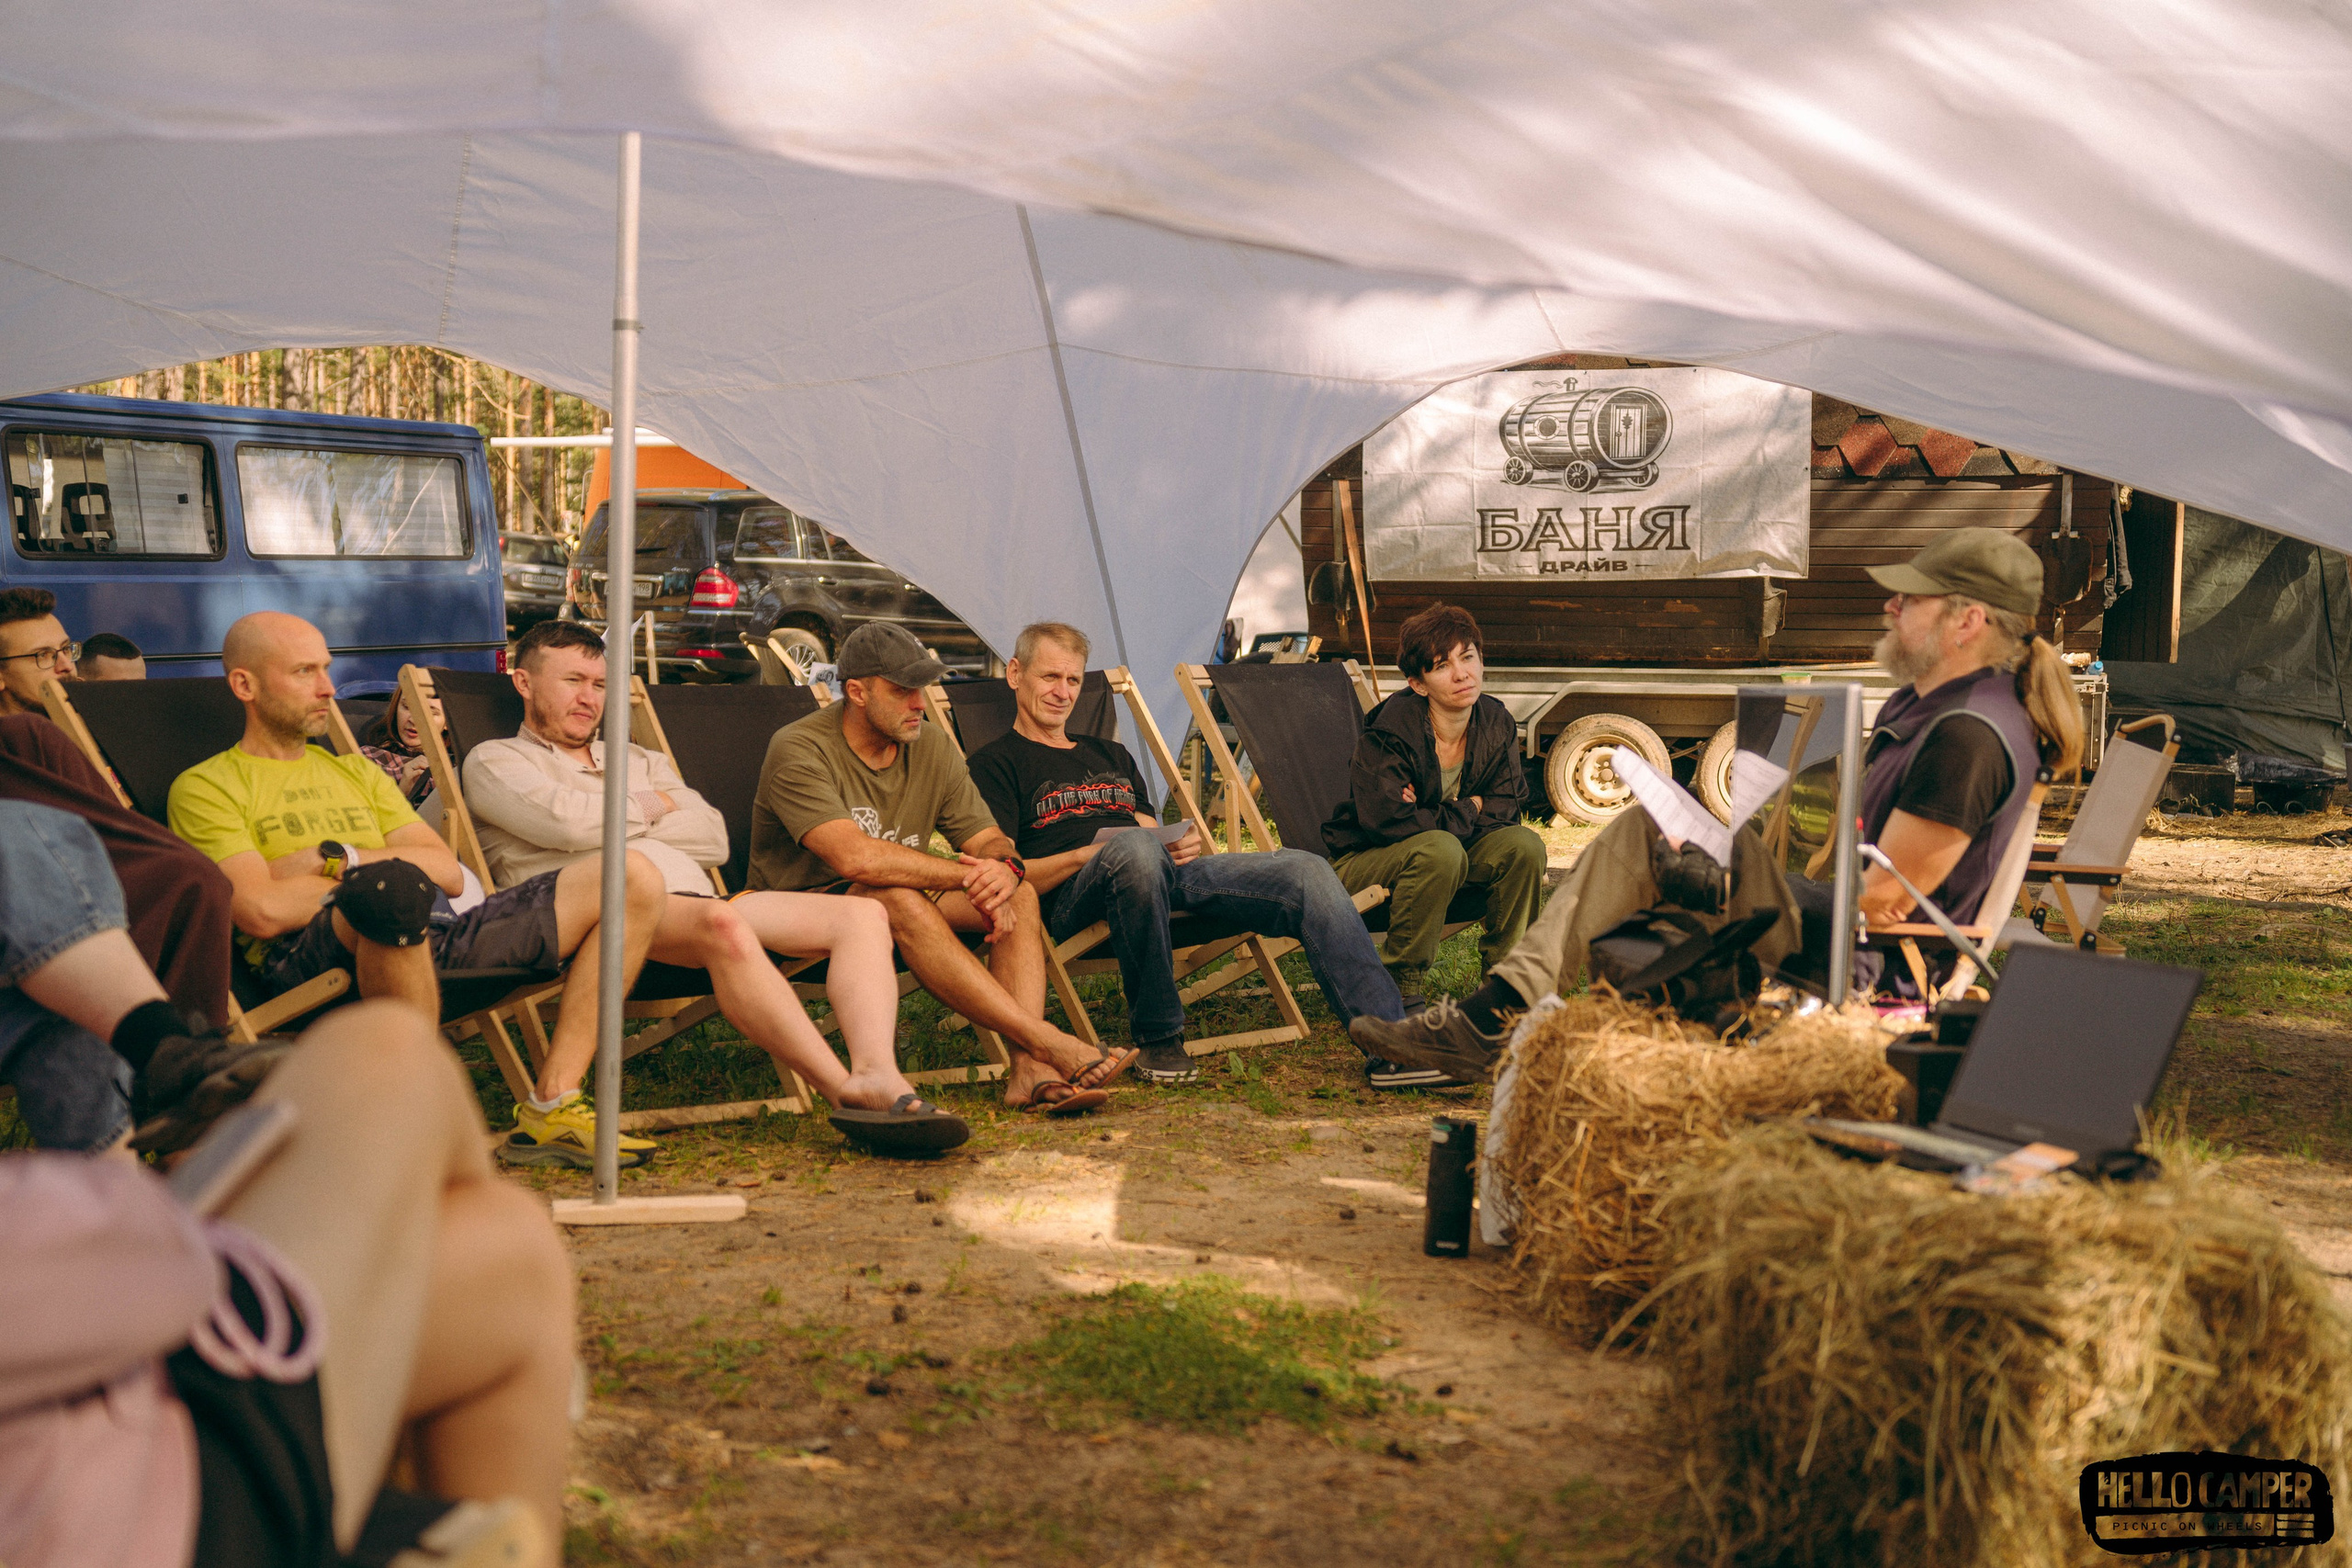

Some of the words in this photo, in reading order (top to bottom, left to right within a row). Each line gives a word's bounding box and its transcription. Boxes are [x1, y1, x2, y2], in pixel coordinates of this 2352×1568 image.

[1476, 505, 1690, 552] БАНЯ
[1540, 558, 1628, 574] ДРАЙВ
[1102, 788, 1113, 804] OF
